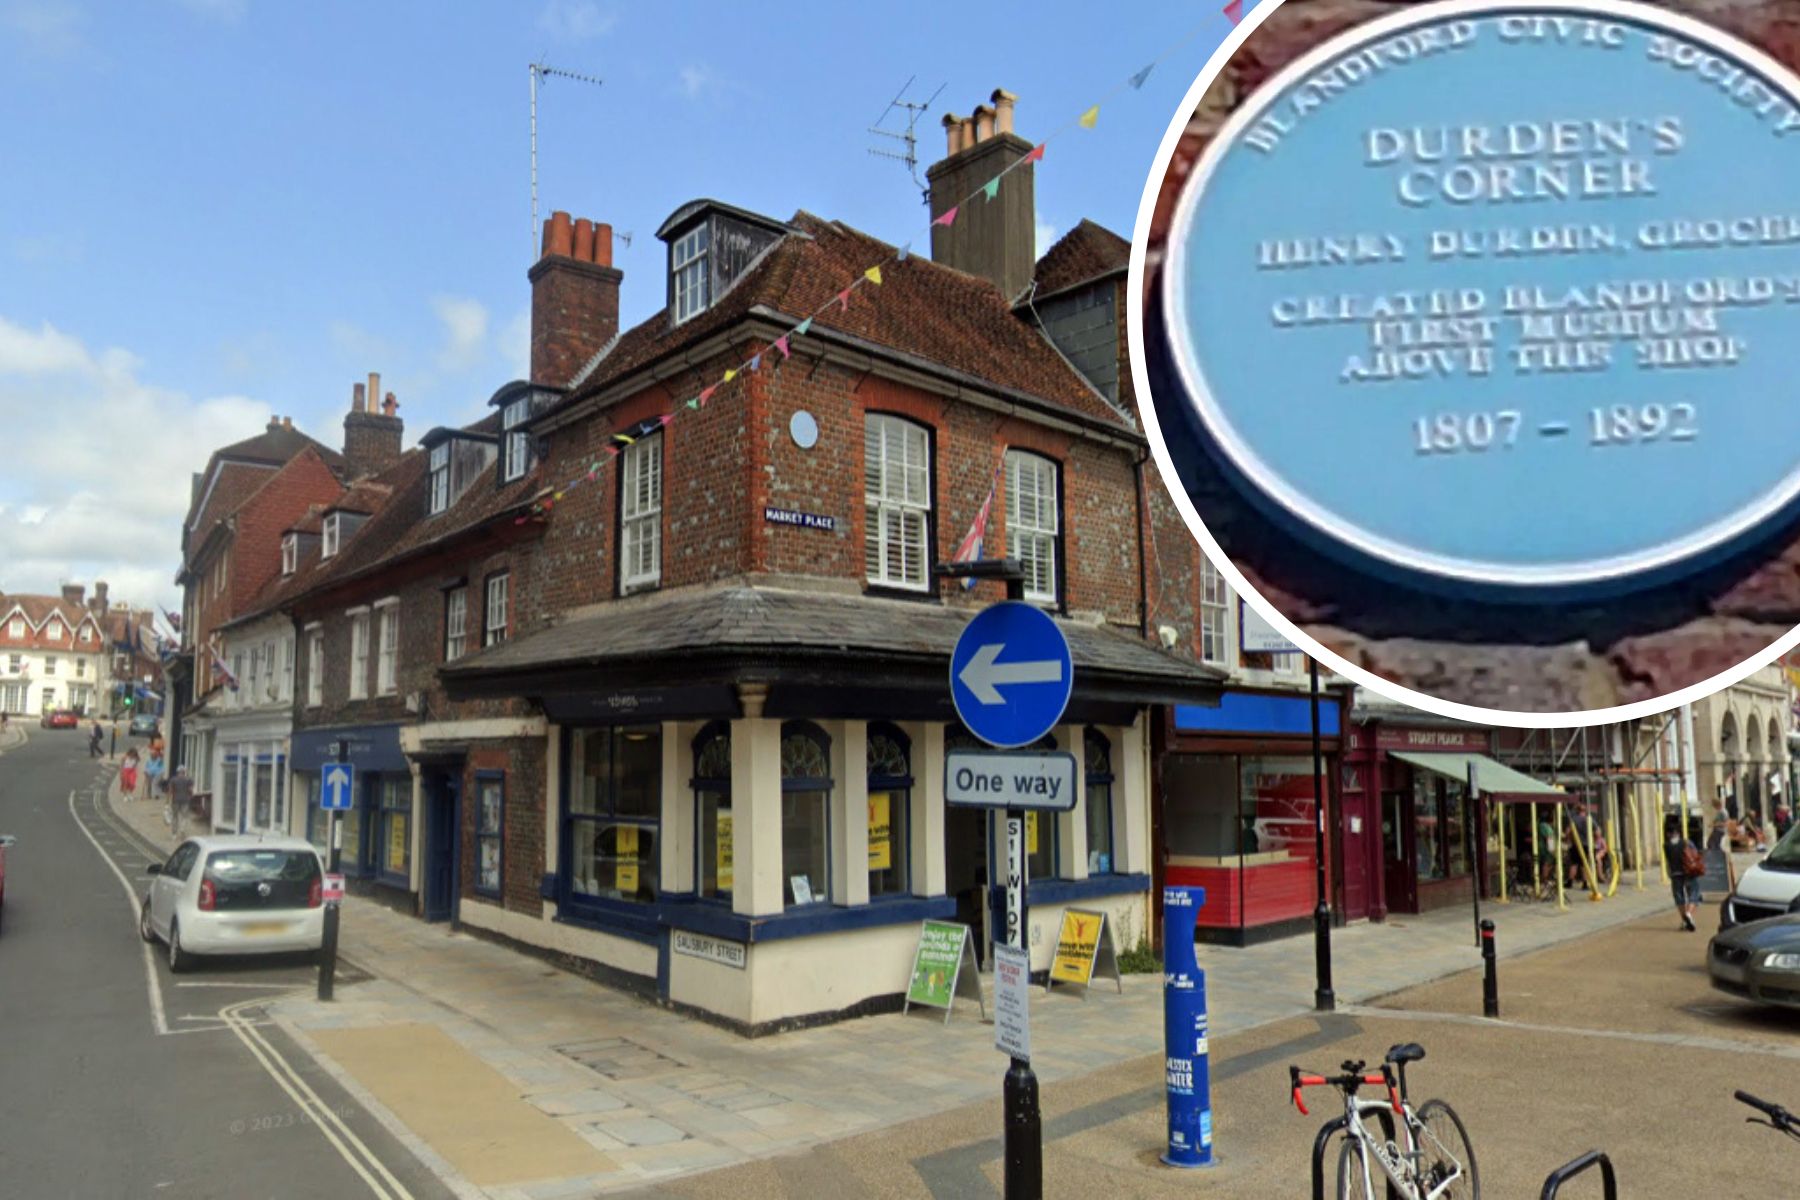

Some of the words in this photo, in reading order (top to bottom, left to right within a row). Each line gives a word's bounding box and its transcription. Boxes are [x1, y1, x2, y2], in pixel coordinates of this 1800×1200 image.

[1243, 20, 1475, 153] BLANDFORD
[1499, 16, 1627, 47] CIVIC
[1368, 116, 1683, 162] DURDEN'S
[1400, 159, 1656, 204] CORNER
[1258, 233, 1405, 267] HENRY
[1270, 287, 1485, 325] CREATED
[1370, 316, 1498, 349] FIRST
[1522, 305, 1718, 340] MUSEUM
[1340, 348, 1493, 382] ABOVE
[1510, 339, 1613, 371] THIS
[1637, 335, 1746, 368] SHOP
[1412, 408, 1521, 454] 1807
[1589, 402, 1699, 447] 1892
[765, 509, 803, 523] MARKET
[805, 515, 832, 529] PLACE
[956, 767, 1003, 792] One
[1014, 775, 1061, 799] way
[677, 935, 714, 955] SALISBURY
[716, 944, 743, 962] STREET
